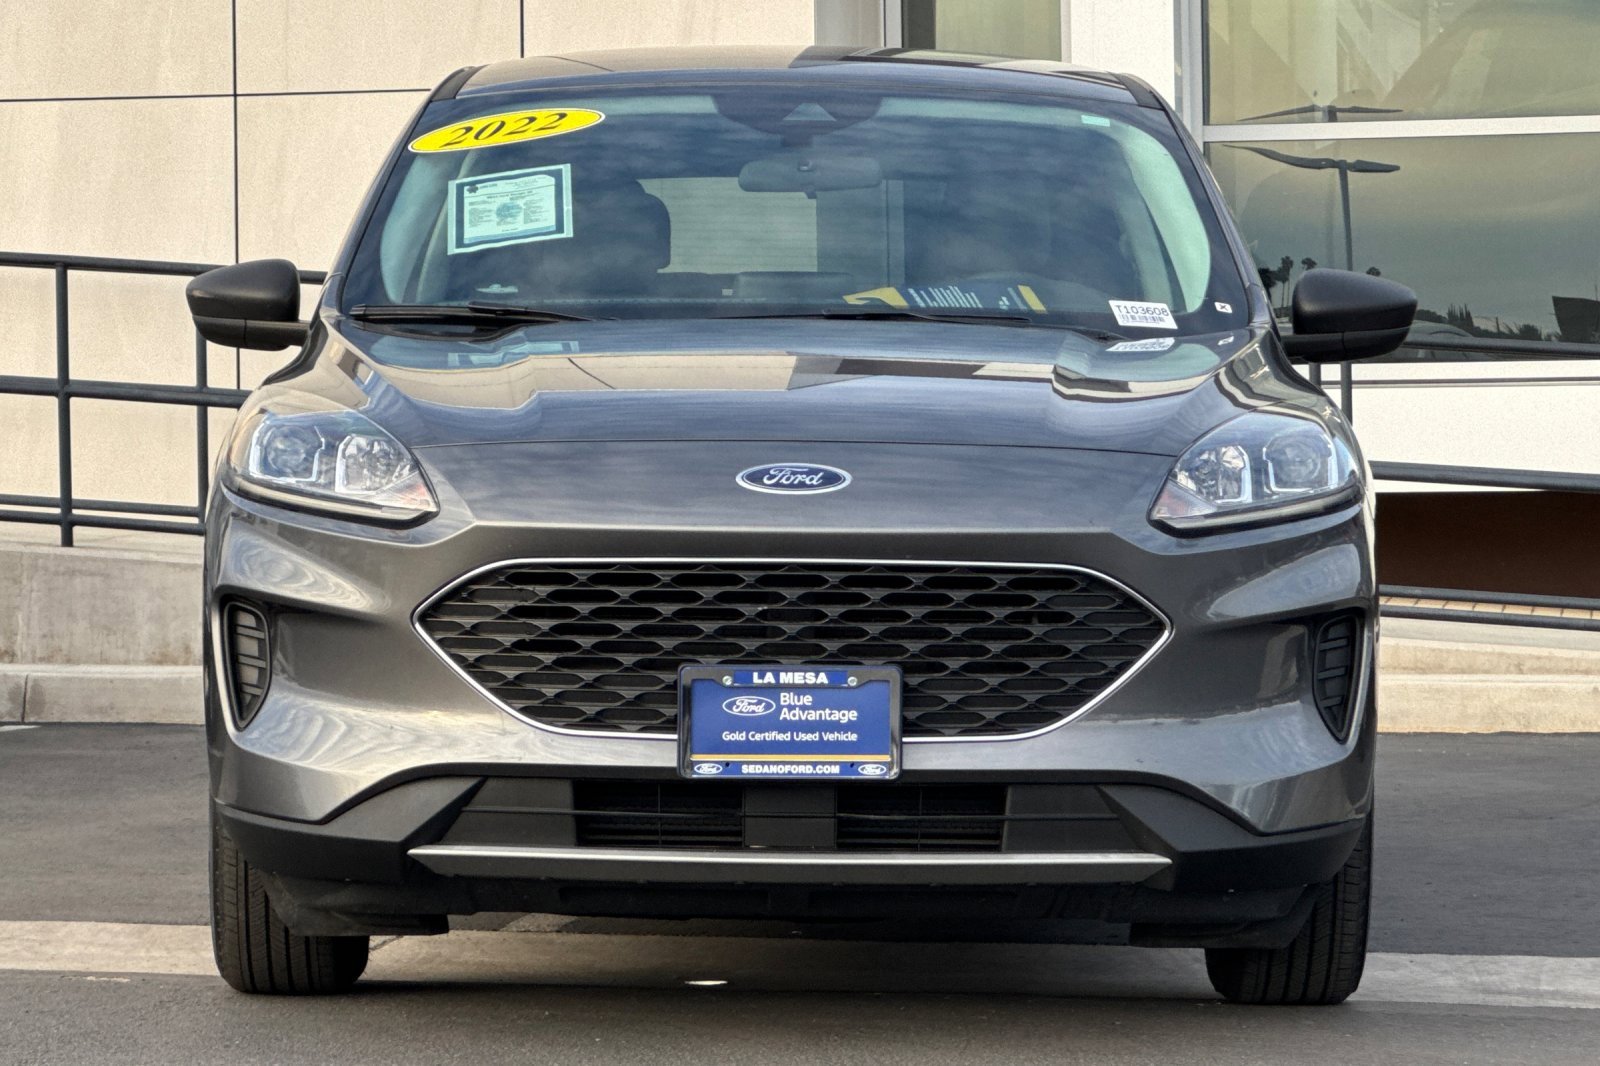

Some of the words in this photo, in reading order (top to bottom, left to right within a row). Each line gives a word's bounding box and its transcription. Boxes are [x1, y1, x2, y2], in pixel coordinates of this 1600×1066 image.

[439, 112, 568, 148] 2022
[1115, 304, 1169, 317] T103608
[763, 467, 825, 485] Ford
[752, 671, 776, 684] LA
[779, 671, 829, 684] MESA
[732, 697, 765, 714] Ford
[779, 692, 813, 706] Blue
[779, 707, 858, 724] Advantage
[722, 730, 746, 742] Gold
[748, 730, 791, 742] Certified
[793, 731, 819, 742] Used
[822, 731, 858, 742] Vehicle
[741, 764, 840, 775] SEDANOFORD.COM
